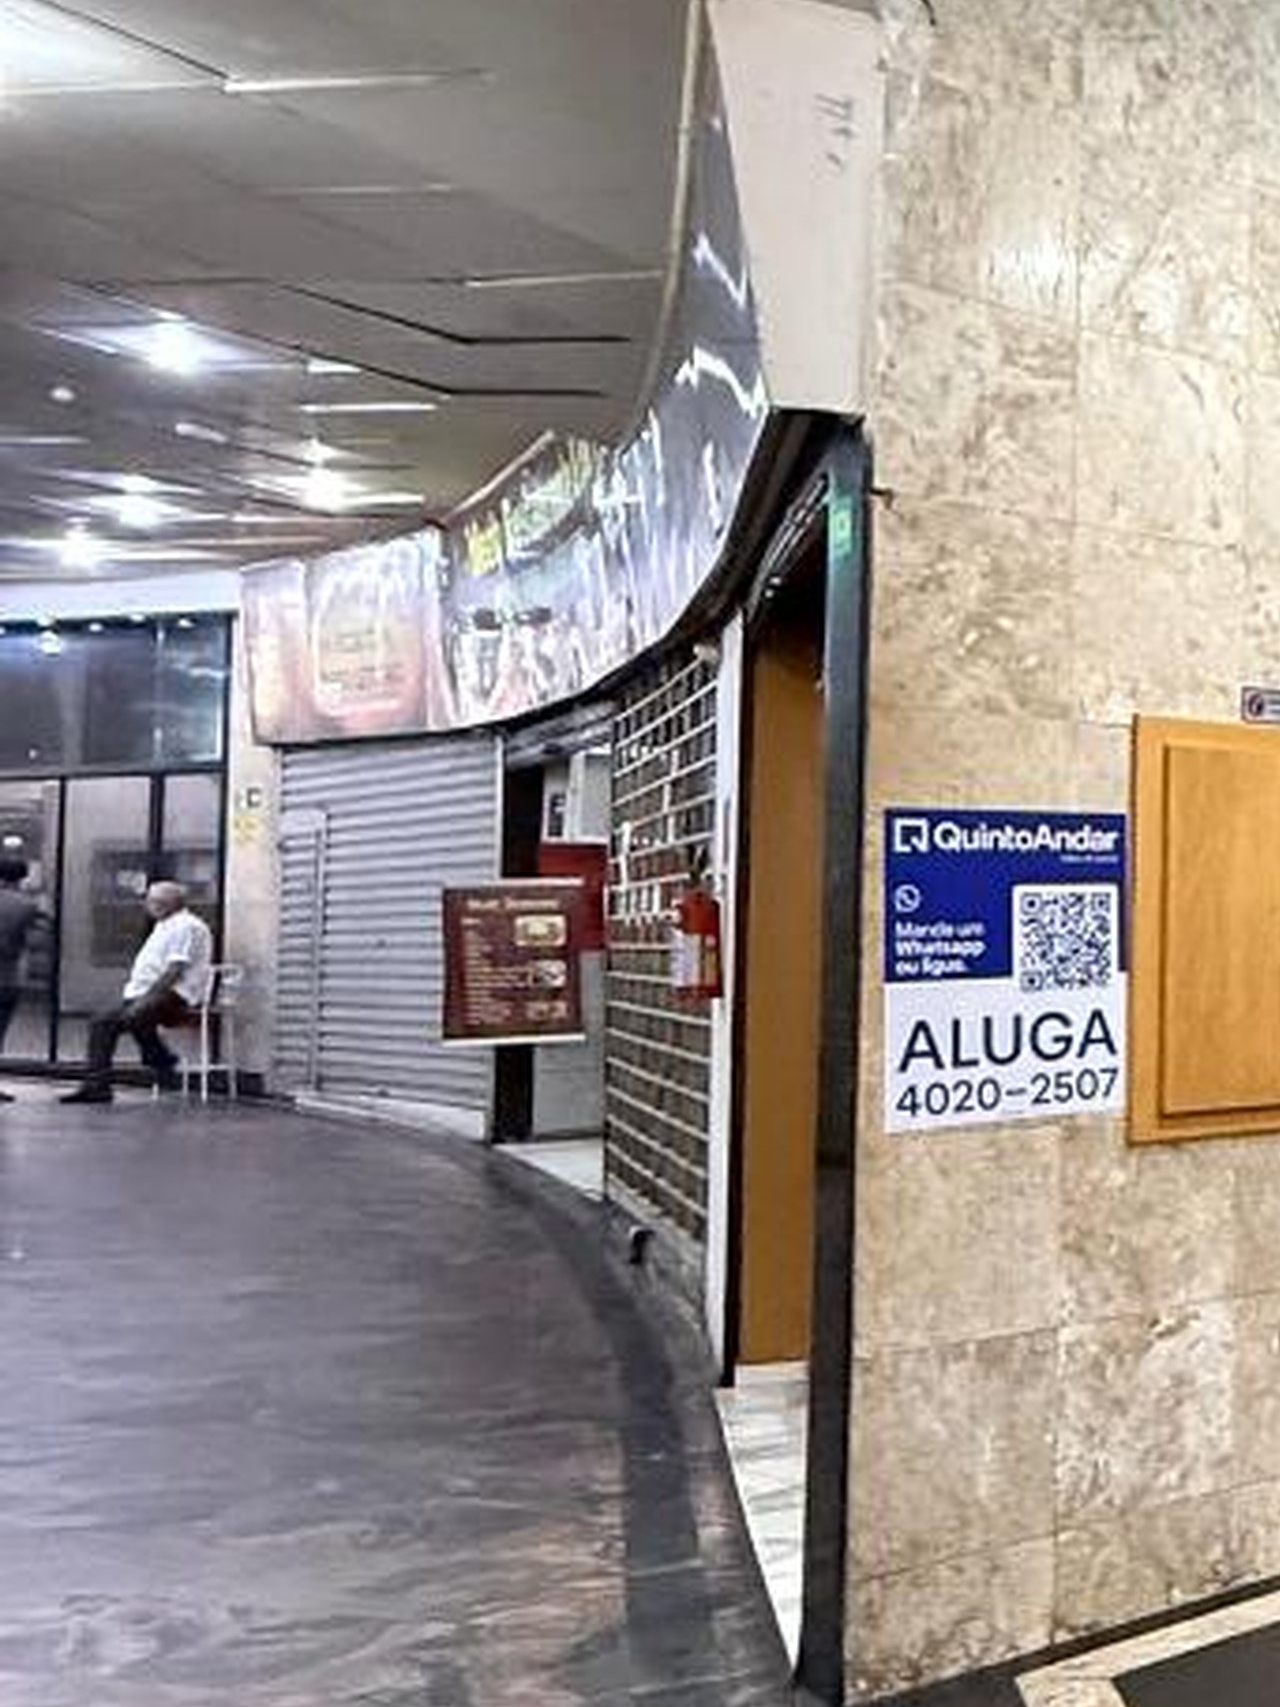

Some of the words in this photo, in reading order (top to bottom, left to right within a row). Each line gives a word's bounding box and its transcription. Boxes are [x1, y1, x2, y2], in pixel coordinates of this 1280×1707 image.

[933, 821, 1119, 852] QuintoAndar
[898, 1009, 1117, 1073] ALUGA
[895, 1067, 1119, 1117] 4020-2507
